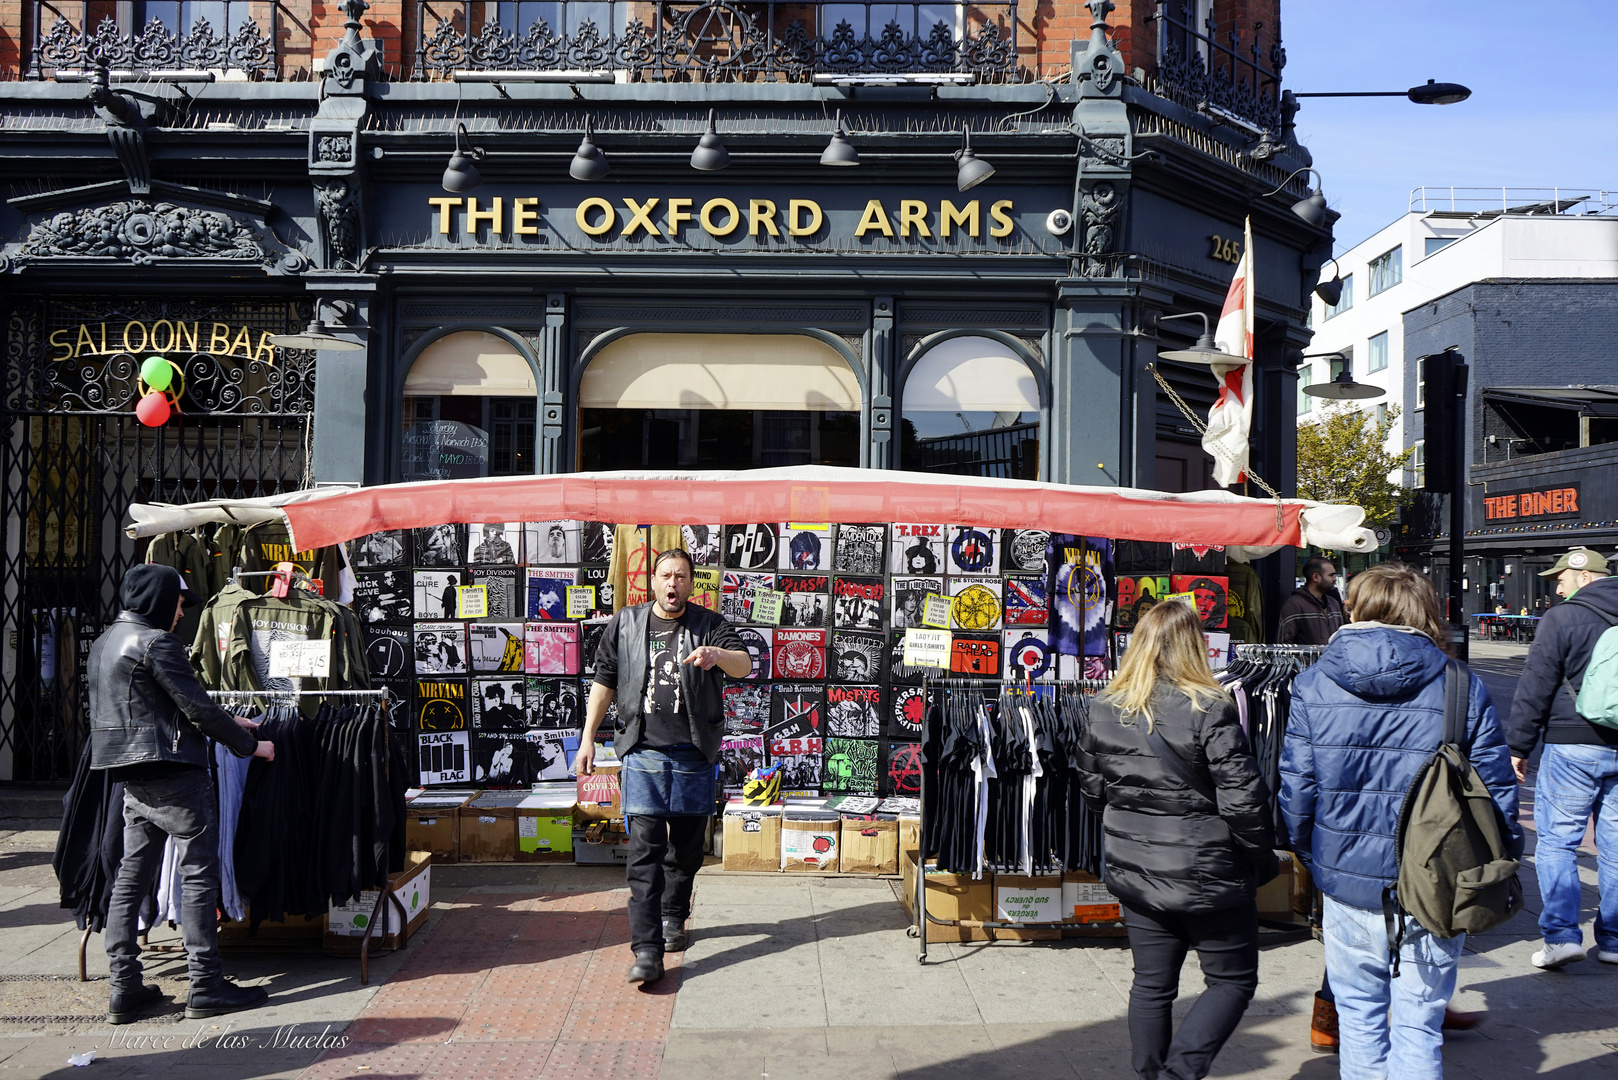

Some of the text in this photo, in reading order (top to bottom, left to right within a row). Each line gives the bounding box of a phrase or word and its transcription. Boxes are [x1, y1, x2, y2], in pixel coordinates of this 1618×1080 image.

[428, 197, 1014, 237] THE OXFORD ARMS
[1212, 234, 1240, 265] 265
[50, 319, 276, 366] SALOON BAR
[441, 434, 470, 447] Norwich
[439, 453, 464, 465] MAYO
[1482, 487, 1579, 519] THE DINER
[899, 525, 941, 537] T.REX
[486, 569, 517, 577] DIVISION
[544, 570, 575, 579] SMITHS
[416, 580, 439, 588] CURE
[786, 576, 827, 594] CLASH
[833, 578, 884, 600] RANCID
[896, 581, 907, 590] THE
[356, 588, 380, 597] CAVE
[757, 590, 781, 600] T-SHIRTS
[929, 595, 951, 605] T-SHIRTS
[251, 619, 311, 632] JOY DIVISION
[369, 626, 408, 638] bauhaus
[777, 631, 821, 641] RAMONES
[833, 634, 885, 649] EXPLOITED
[924, 643, 946, 651] T-SHIRTS
[418, 682, 464, 699] NIRVANA
[827, 687, 880, 703] MISFITS
[421, 733, 454, 745] BLACK
[529, 729, 576, 742] The Smiths
[770, 738, 822, 756] G.B.H
[440, 770, 464, 781] FLAG
[1004, 895, 1050, 905] SUD QUERCY
[1007, 909, 1039, 918] VERGERS
